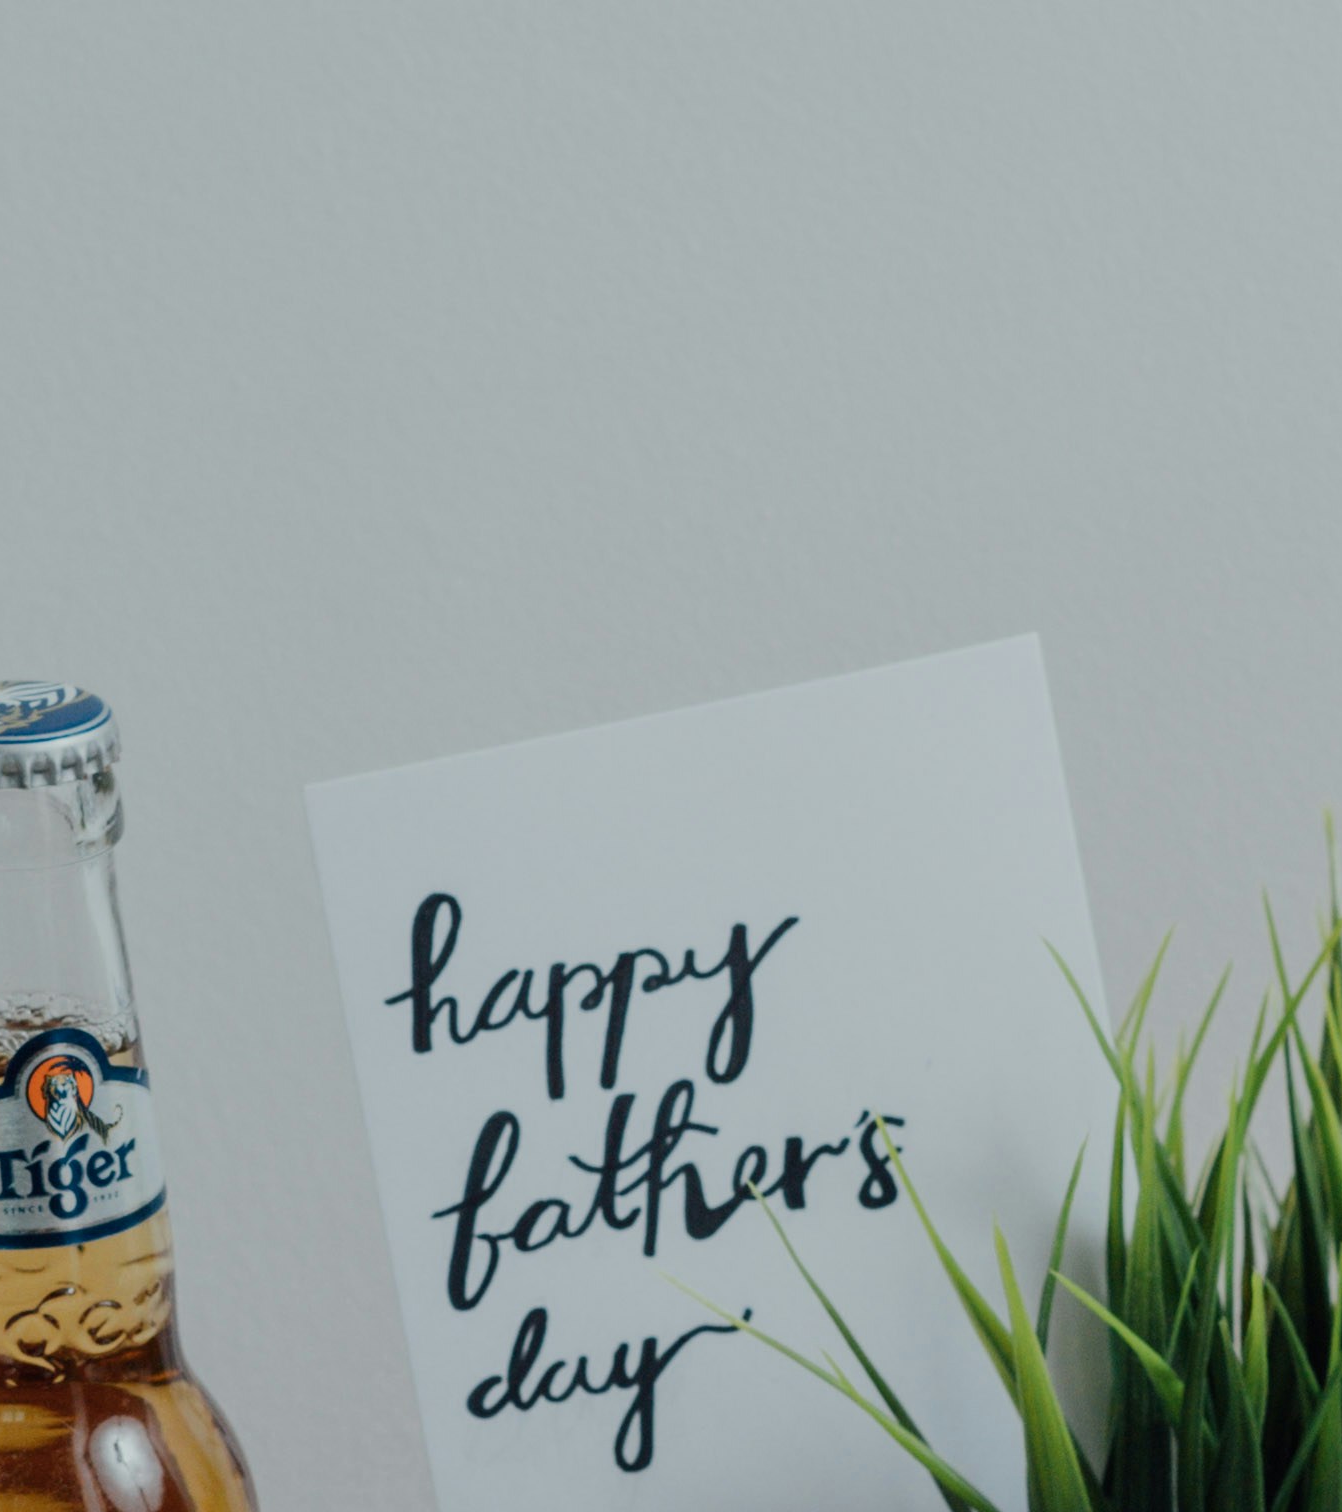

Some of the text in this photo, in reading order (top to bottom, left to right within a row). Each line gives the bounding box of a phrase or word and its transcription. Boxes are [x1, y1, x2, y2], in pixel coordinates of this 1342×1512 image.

[384, 892, 800, 1100] happy
[2, 1205, 44, 1216] SINCE
[430, 1079, 906, 1311] father's
[466, 1307, 753, 1473] day
